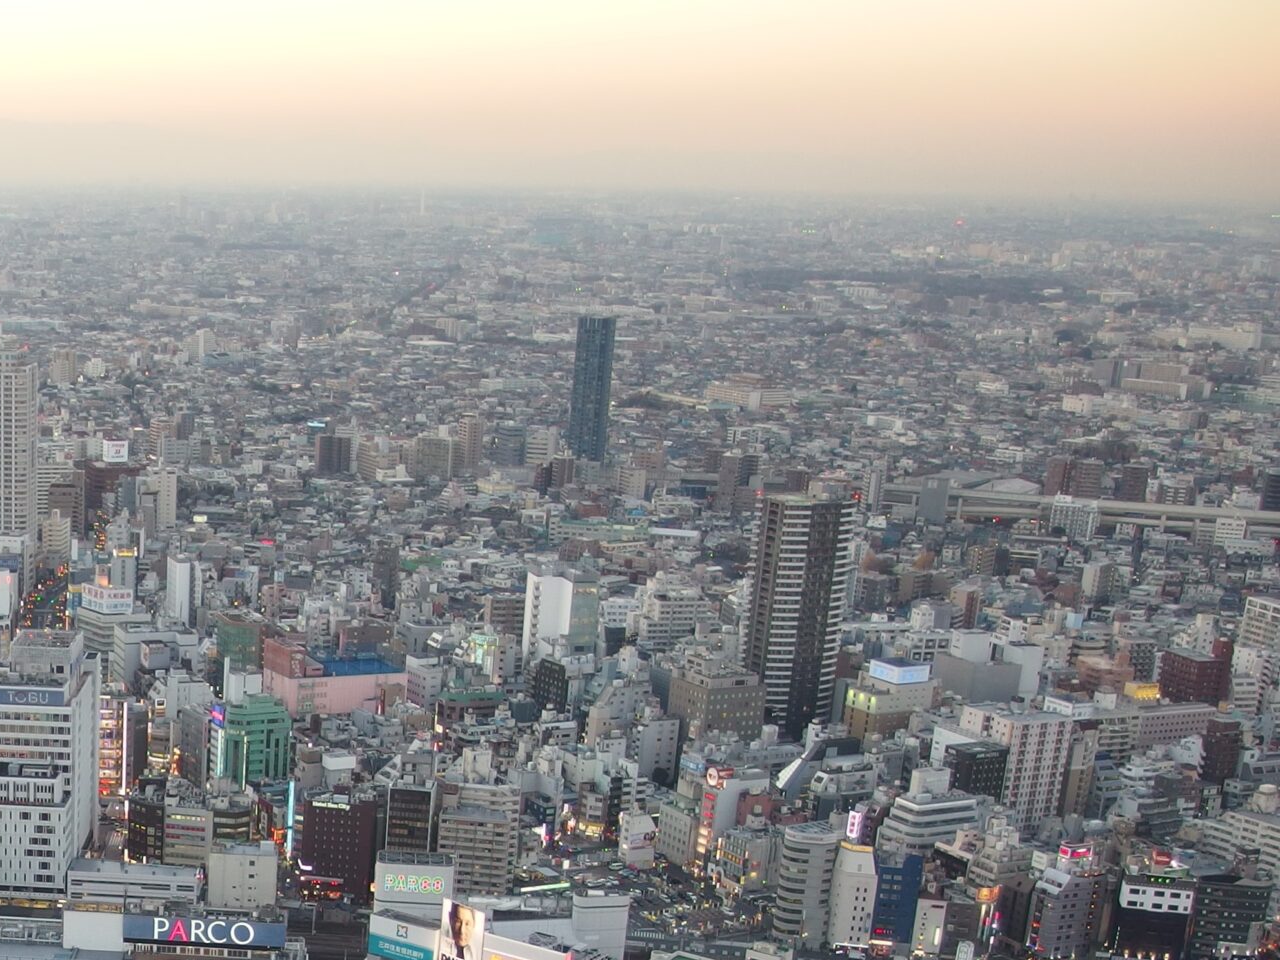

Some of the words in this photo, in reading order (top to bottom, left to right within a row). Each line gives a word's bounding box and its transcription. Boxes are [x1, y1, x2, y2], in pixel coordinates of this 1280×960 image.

[8, 691, 49, 704] TOBU
[384, 874, 445, 895] PARCO
[153, 917, 255, 945] PARCO
